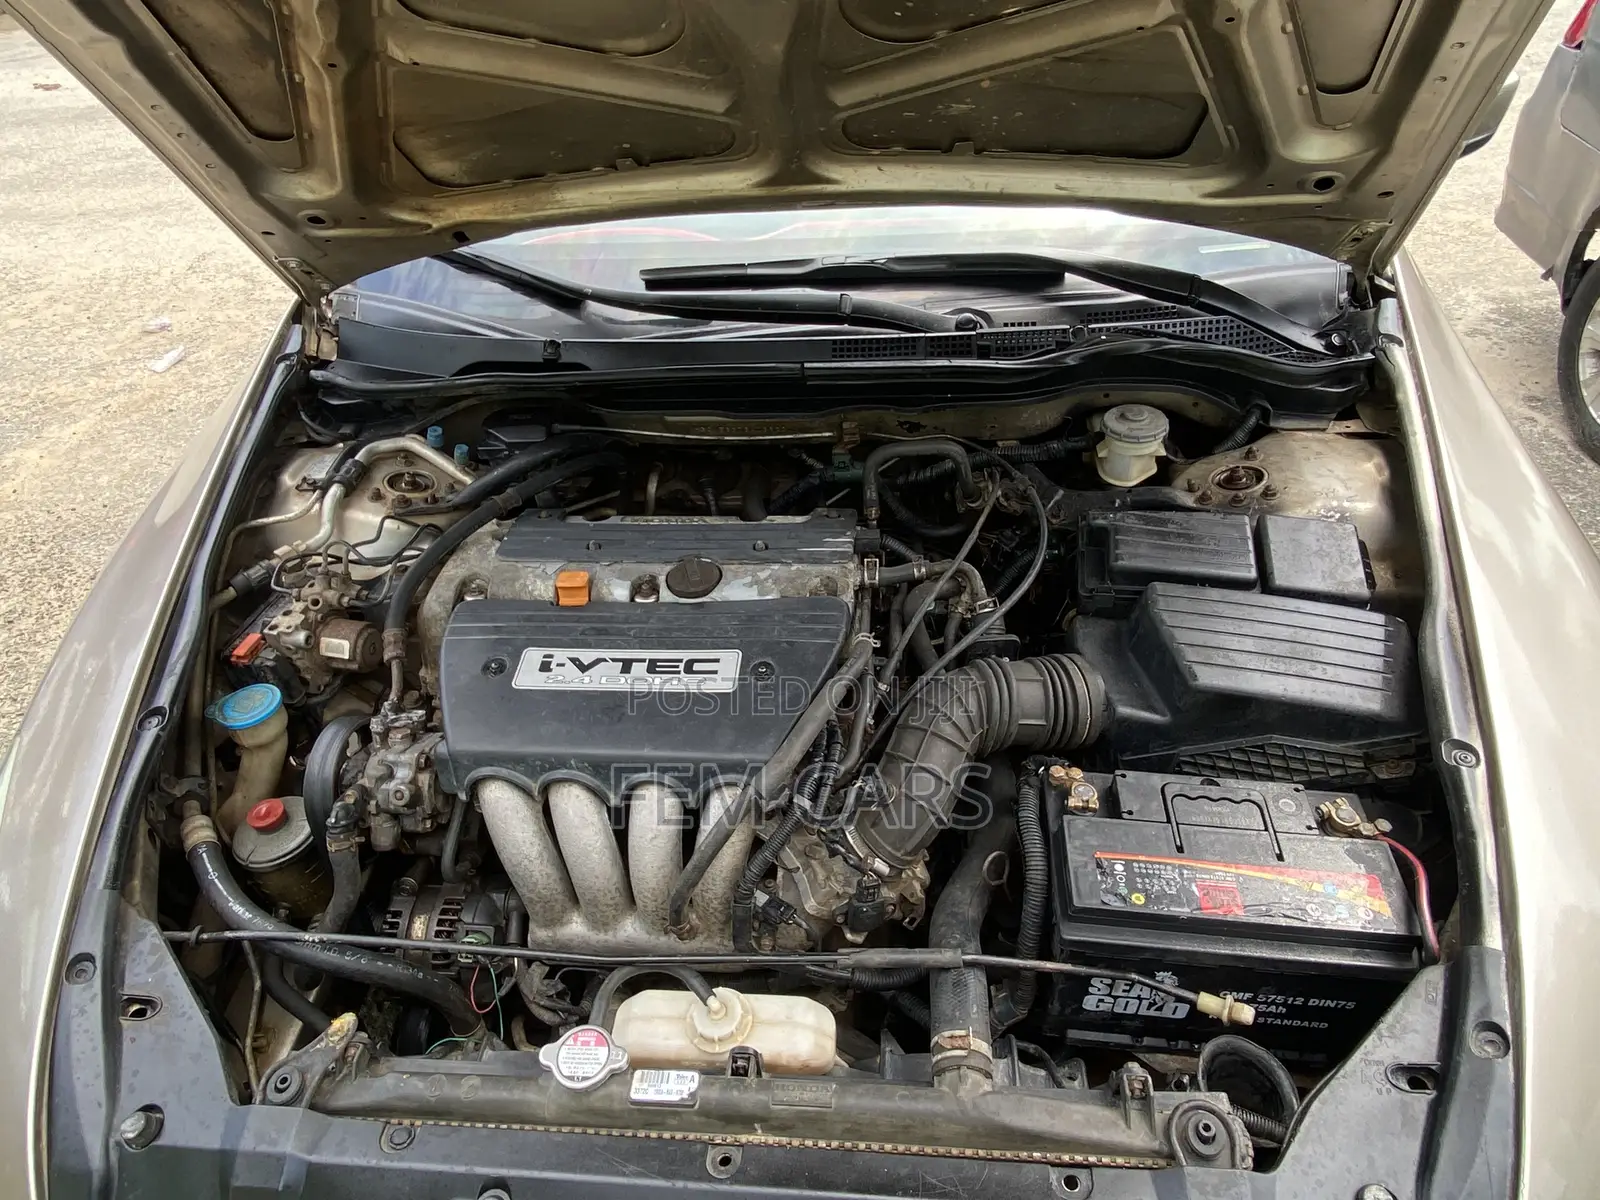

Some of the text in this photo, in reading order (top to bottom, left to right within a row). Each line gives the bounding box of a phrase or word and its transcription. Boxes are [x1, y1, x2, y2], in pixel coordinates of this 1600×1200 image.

[538, 653, 721, 675] i-VTEC
[544, 674, 593, 685] 2.4
[1088, 977, 1152, 999] SEA
[1082, 994, 1191, 1019] GOLD
[1257, 994, 1305, 1006] 57512
[1308, 998, 1357, 1010] DIN75
[1256, 1016, 1329, 1029] STANDARD
